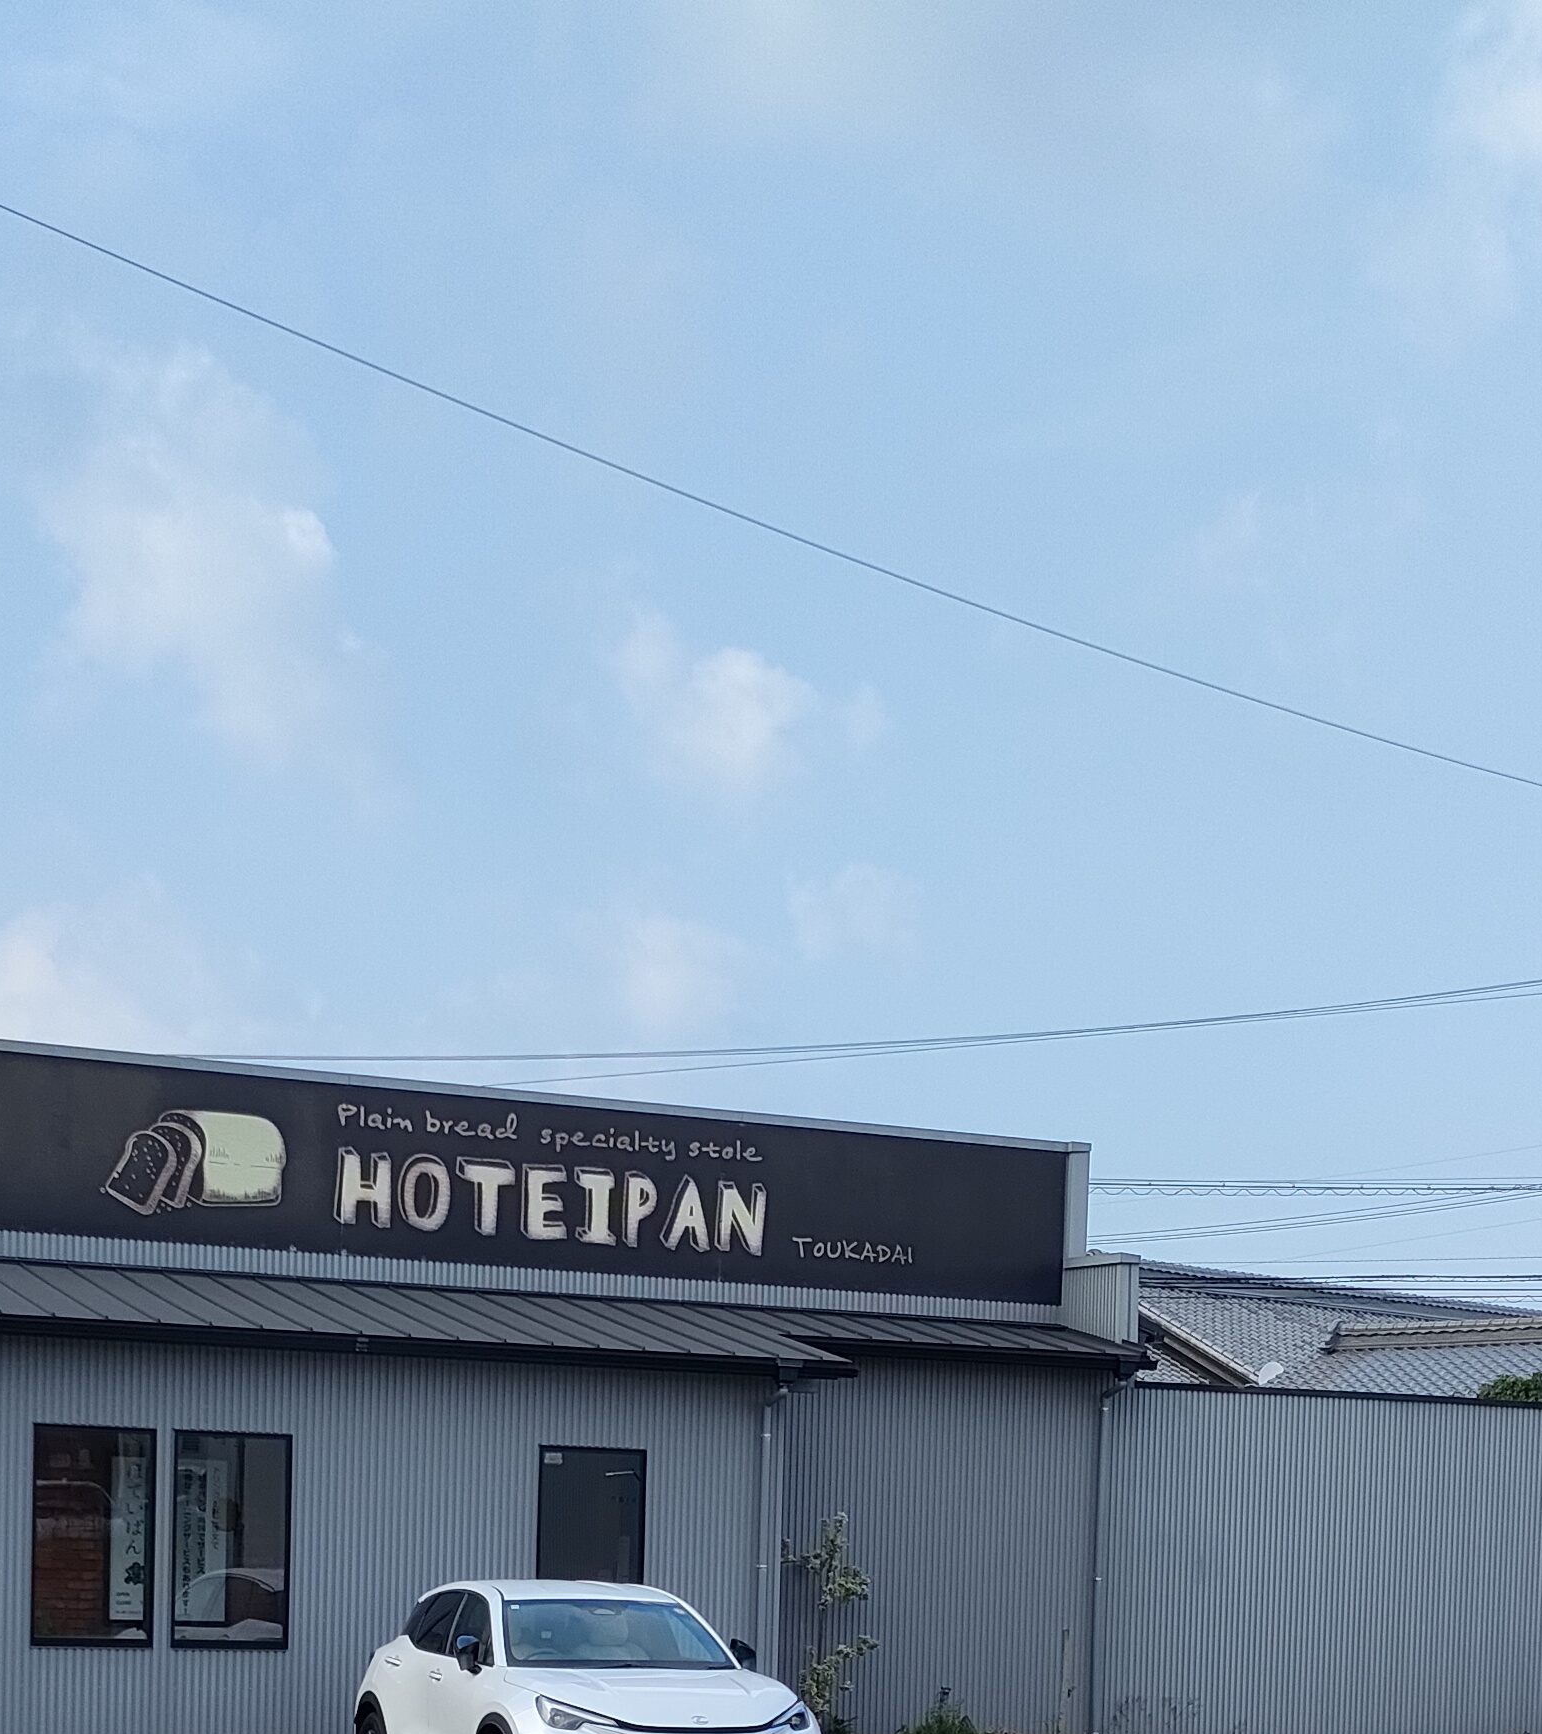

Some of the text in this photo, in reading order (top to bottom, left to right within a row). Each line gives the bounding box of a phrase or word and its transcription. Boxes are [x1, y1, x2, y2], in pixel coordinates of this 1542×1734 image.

[336, 1103, 413, 1133] Plain
[426, 1110, 518, 1140] bread
[540, 1127, 676, 1161] specialty
[333, 1146, 768, 1258] HOTEIPAN
